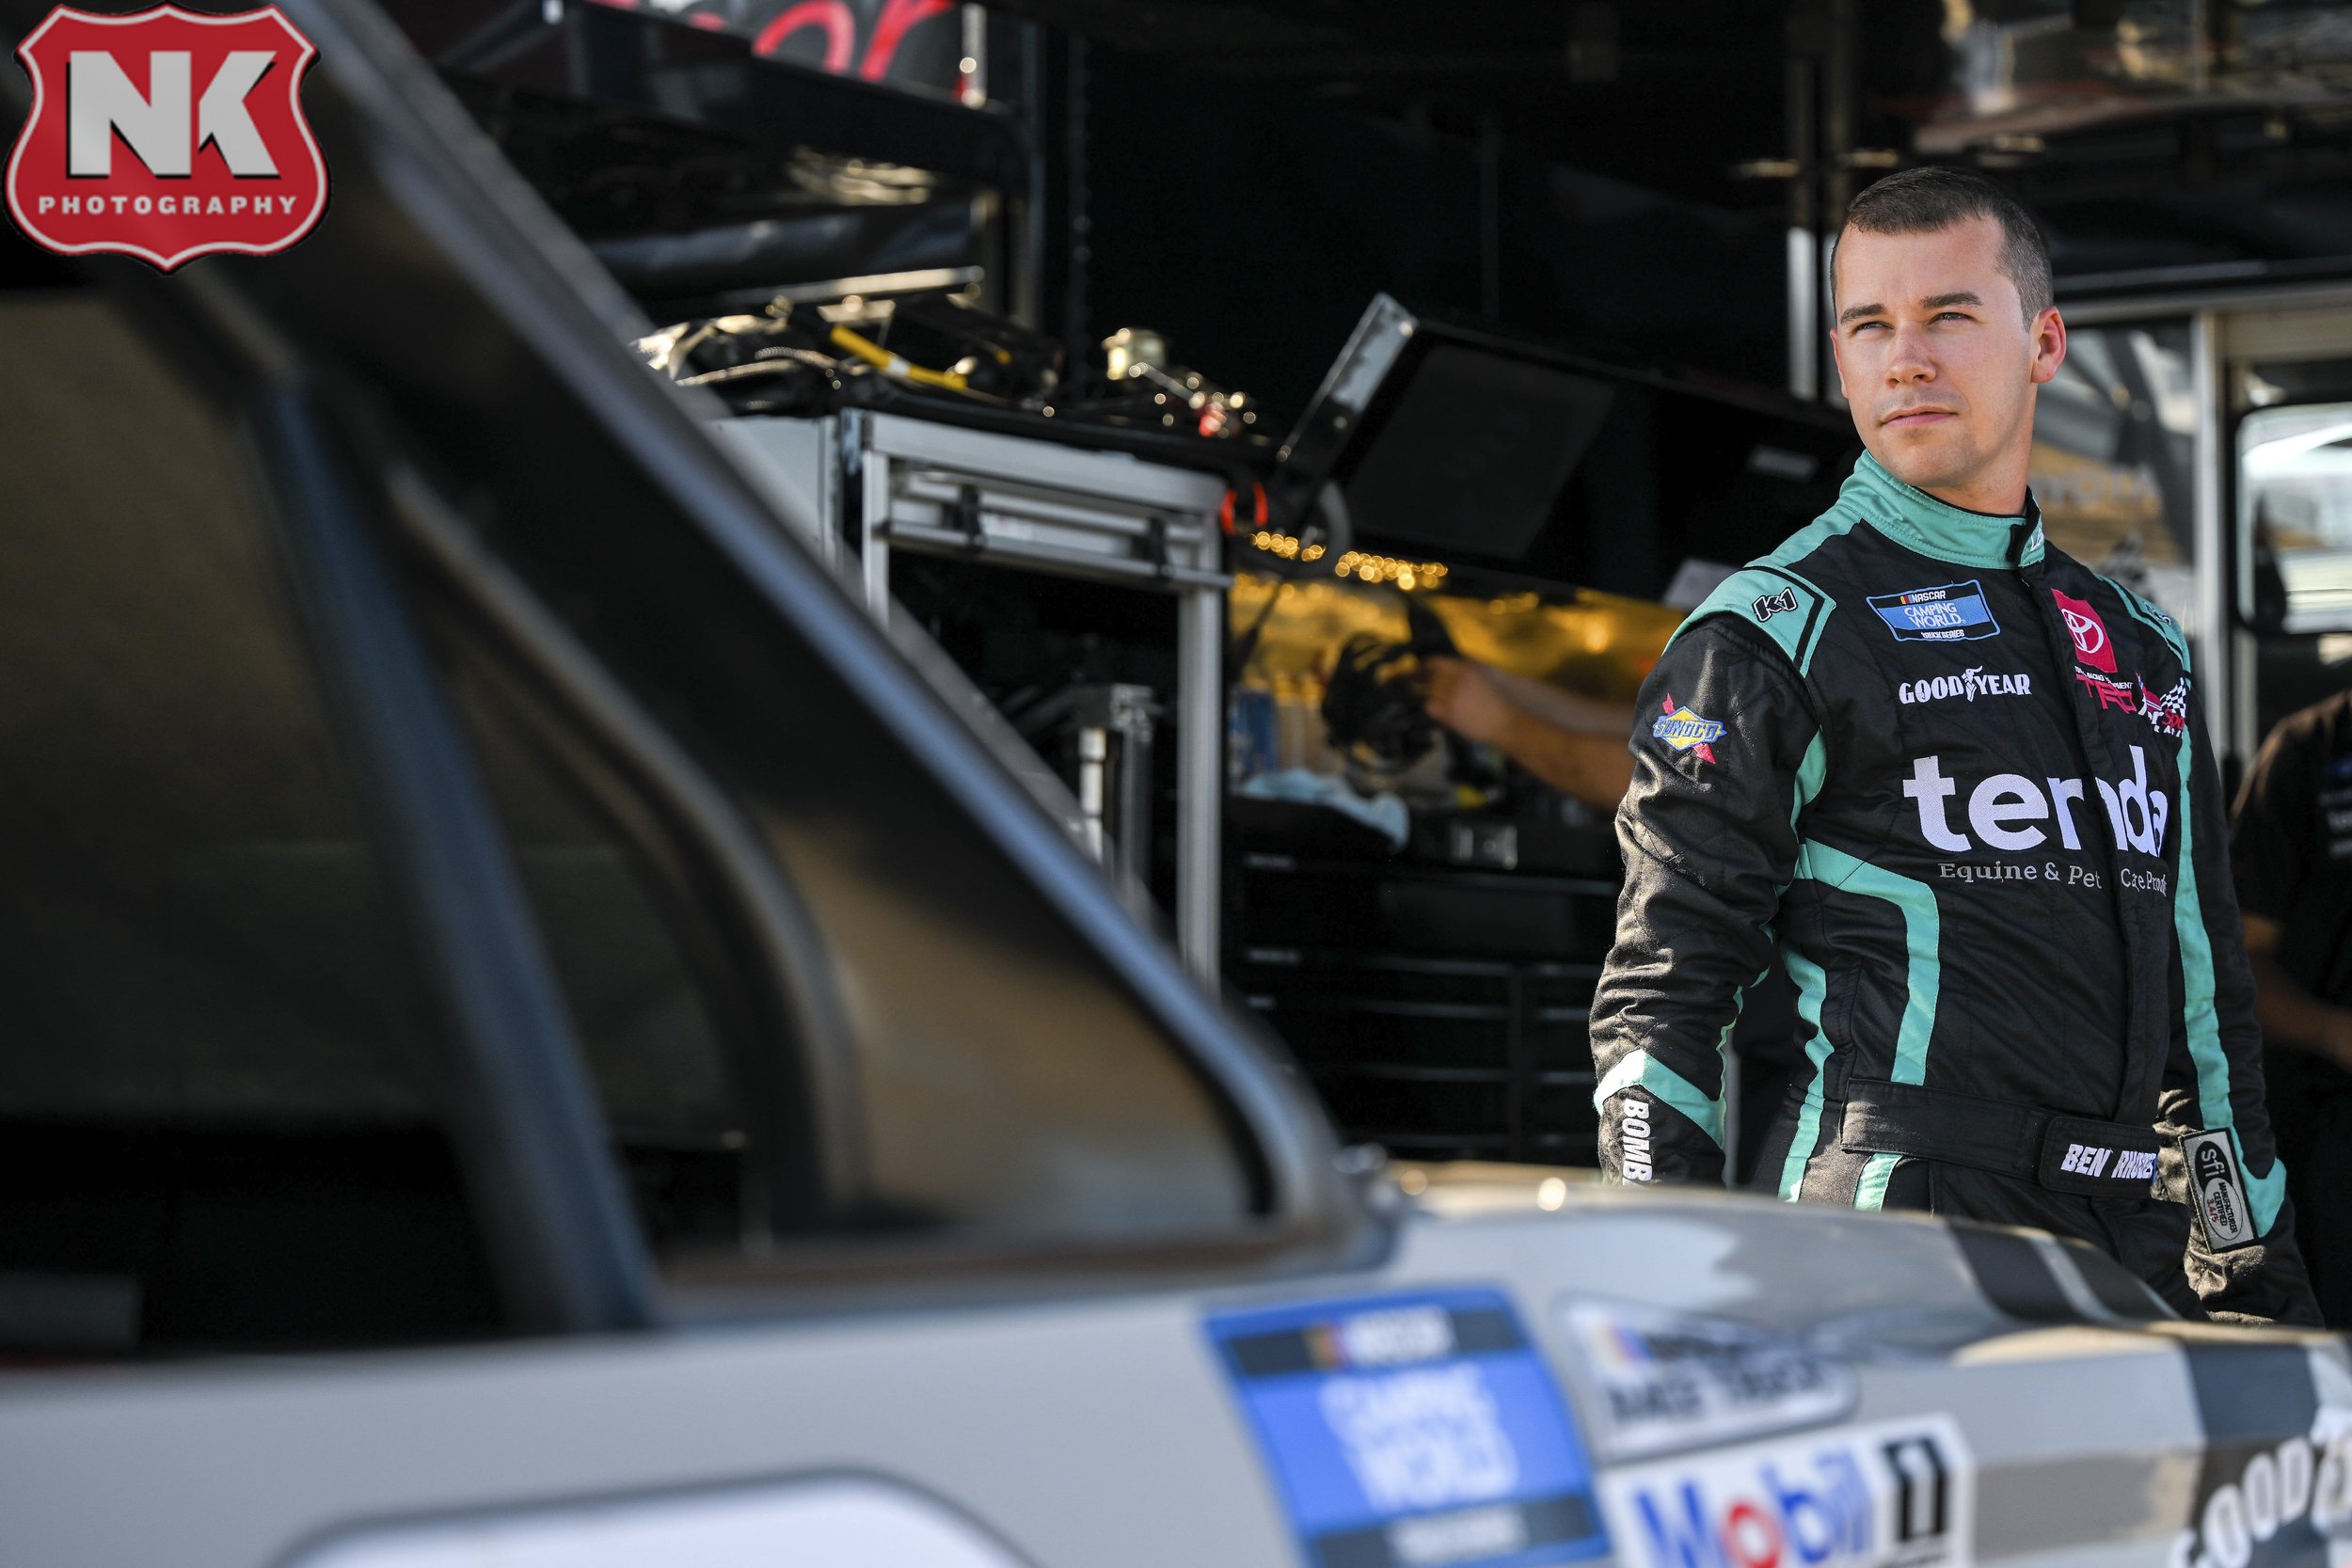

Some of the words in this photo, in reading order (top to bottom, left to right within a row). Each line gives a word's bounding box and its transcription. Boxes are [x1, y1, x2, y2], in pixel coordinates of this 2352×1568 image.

[1904, 602, 1958, 617] CAMPING
[1912, 590, 1947, 603] NASCAR
[1908, 612, 1963, 628] WORLD
[1899, 665, 2032, 704] GOODYEAR
[1654, 719, 1719, 739] SUNOCO
[1938, 861, 2038, 883] Equine
[2044, 862, 2060, 881] &
[2068, 865, 2102, 889] Pet
[1622, 1098, 1653, 1185] BOMB
[2060, 1143, 2111, 1177] BEN
[2201, 1148, 2226, 1178] sfi
[2213, 1191, 2228, 1227] CERTIFIED
[2218, 1181, 2238, 1234] MANUFACTURER
